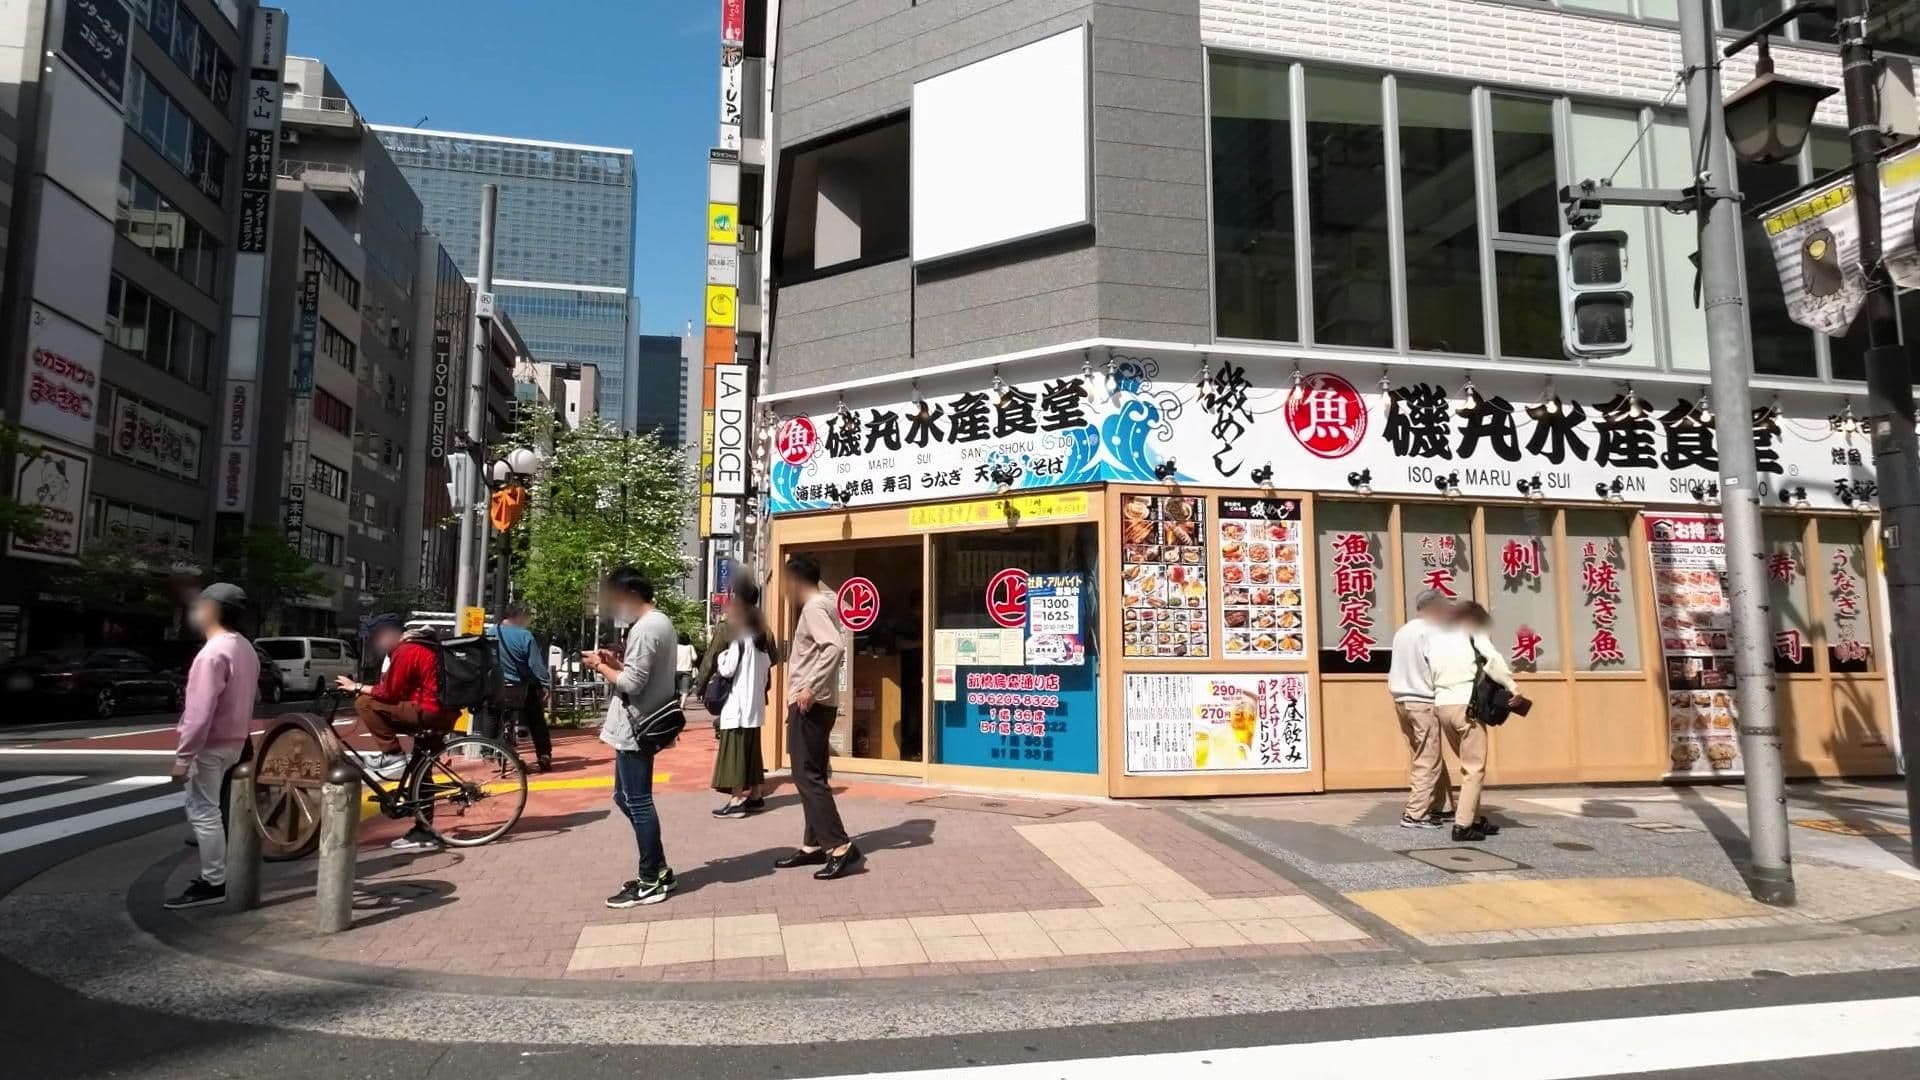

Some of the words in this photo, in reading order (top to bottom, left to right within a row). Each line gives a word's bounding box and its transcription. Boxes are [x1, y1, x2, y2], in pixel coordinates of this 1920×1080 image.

[253, 86, 275, 120] 東山
[259, 134, 272, 184] ビリヤード
[434, 352, 448, 397] TOYO
[721, 372, 742, 399] LA
[431, 401, 446, 458] DENSO
[824, 376, 1089, 458] 磯丸水産食堂
[1300, 387, 1351, 442] 魚
[719, 409, 742, 482] DOLCE
[837, 463, 851, 474] ISO
[868, 457, 895, 471] MARU
[916, 452, 932, 465] SUI
[961, 447, 982, 460] SAN
[999, 441, 1034, 455] SHOKU
[1058, 435, 1073, 448] DO
[882, 474, 912, 493] 寿司
[921, 467, 963, 488] うなぎ
[974, 462, 1023, 482] 天ら
[1033, 455, 1064, 475] そば
[1408, 467, 1433, 483] ISO
[1465, 469, 1512, 486] MARU
[1548, 473, 1571, 489] SUI
[1616, 475, 1645, 493] SAN
[1674, 521, 1725, 541] お持ち
[1332, 533, 1378, 663] 漁師定食
[1769, 550, 1802, 664] 寿司
[1832, 549, 1860, 616] うなぎ
[1583, 559, 1624, 662] 焼き魚
[967, 673, 1060, 691] 新橋烏森通り店
[1260, 720, 1271, 766] ドリンク
[1268, 680, 1282, 764] タイムサービス
[1282, 698, 1304, 763] 昼飲み
